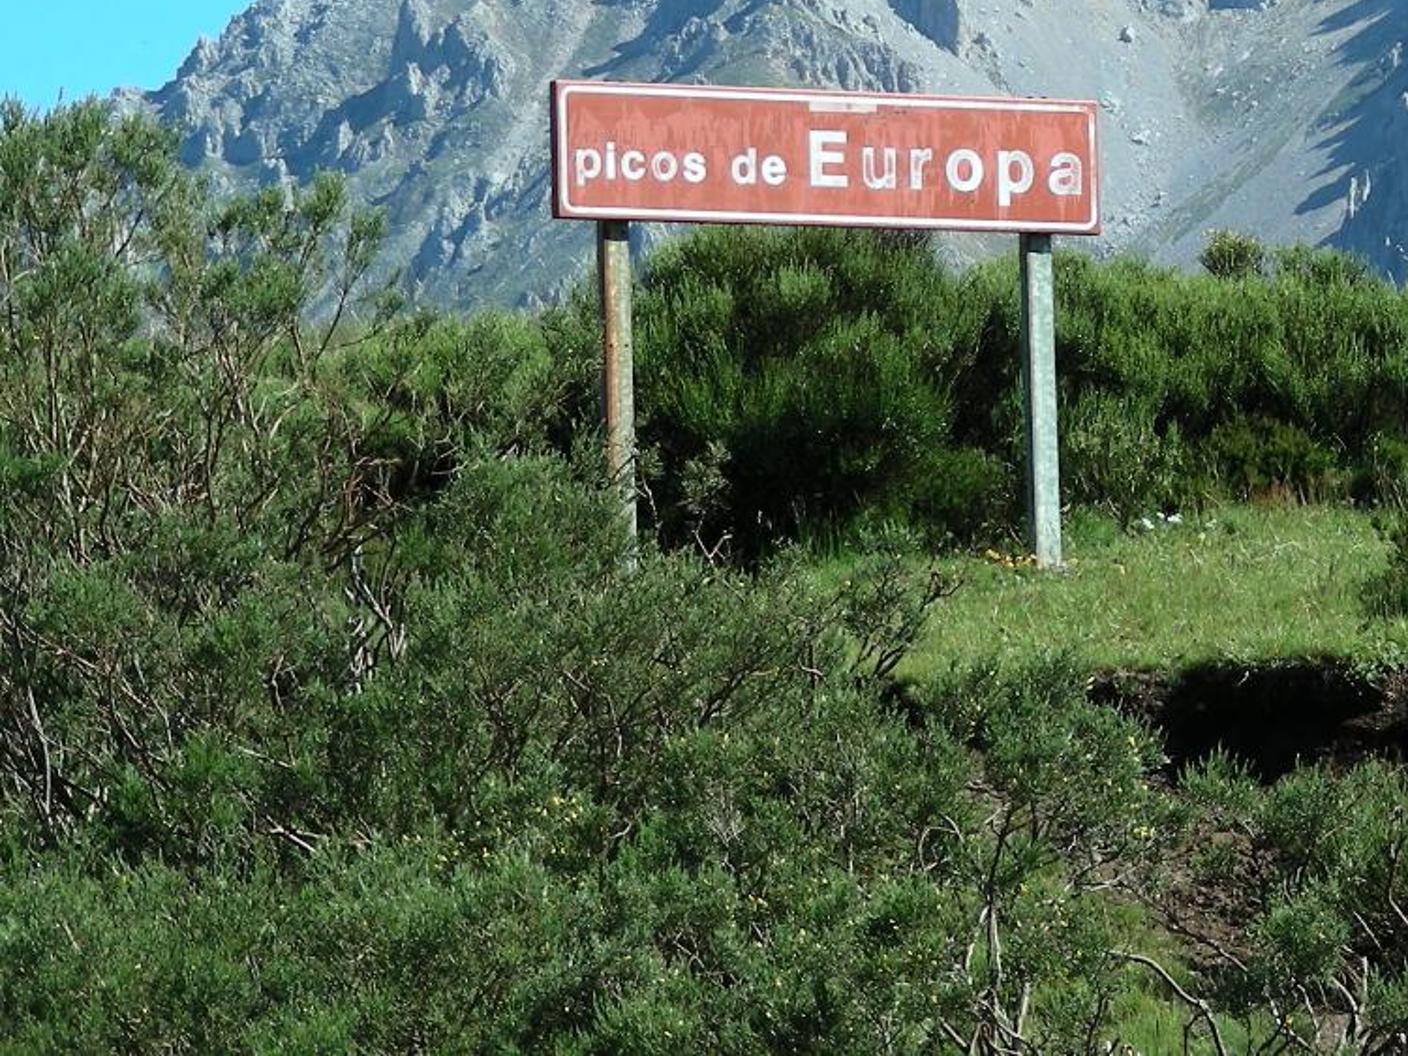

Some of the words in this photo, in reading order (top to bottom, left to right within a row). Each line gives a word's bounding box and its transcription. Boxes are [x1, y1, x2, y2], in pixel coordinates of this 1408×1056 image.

[575, 142, 708, 186] picos
[731, 148, 787, 186] de
[809, 130, 1082, 207] Europa
